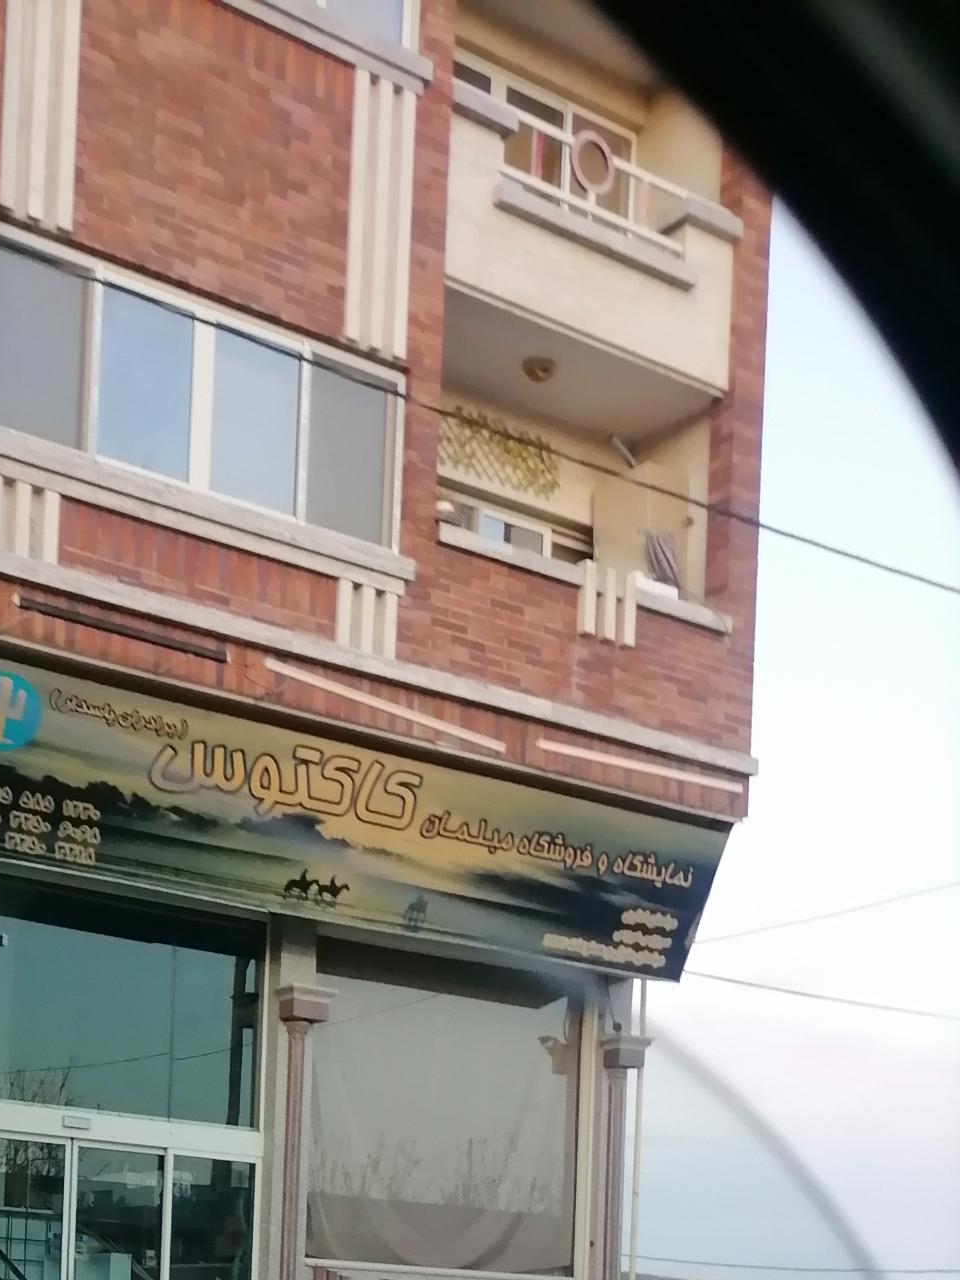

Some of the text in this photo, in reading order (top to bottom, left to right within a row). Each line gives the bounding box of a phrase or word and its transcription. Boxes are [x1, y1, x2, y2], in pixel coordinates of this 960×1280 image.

[149, 740, 423, 831] کاکتوس
[421, 812, 514, 856] مبلمان
[518, 832, 593, 871] فروشگاه
[597, 855, 607, 876] و
[614, 851, 693, 888] نمایشگاه
